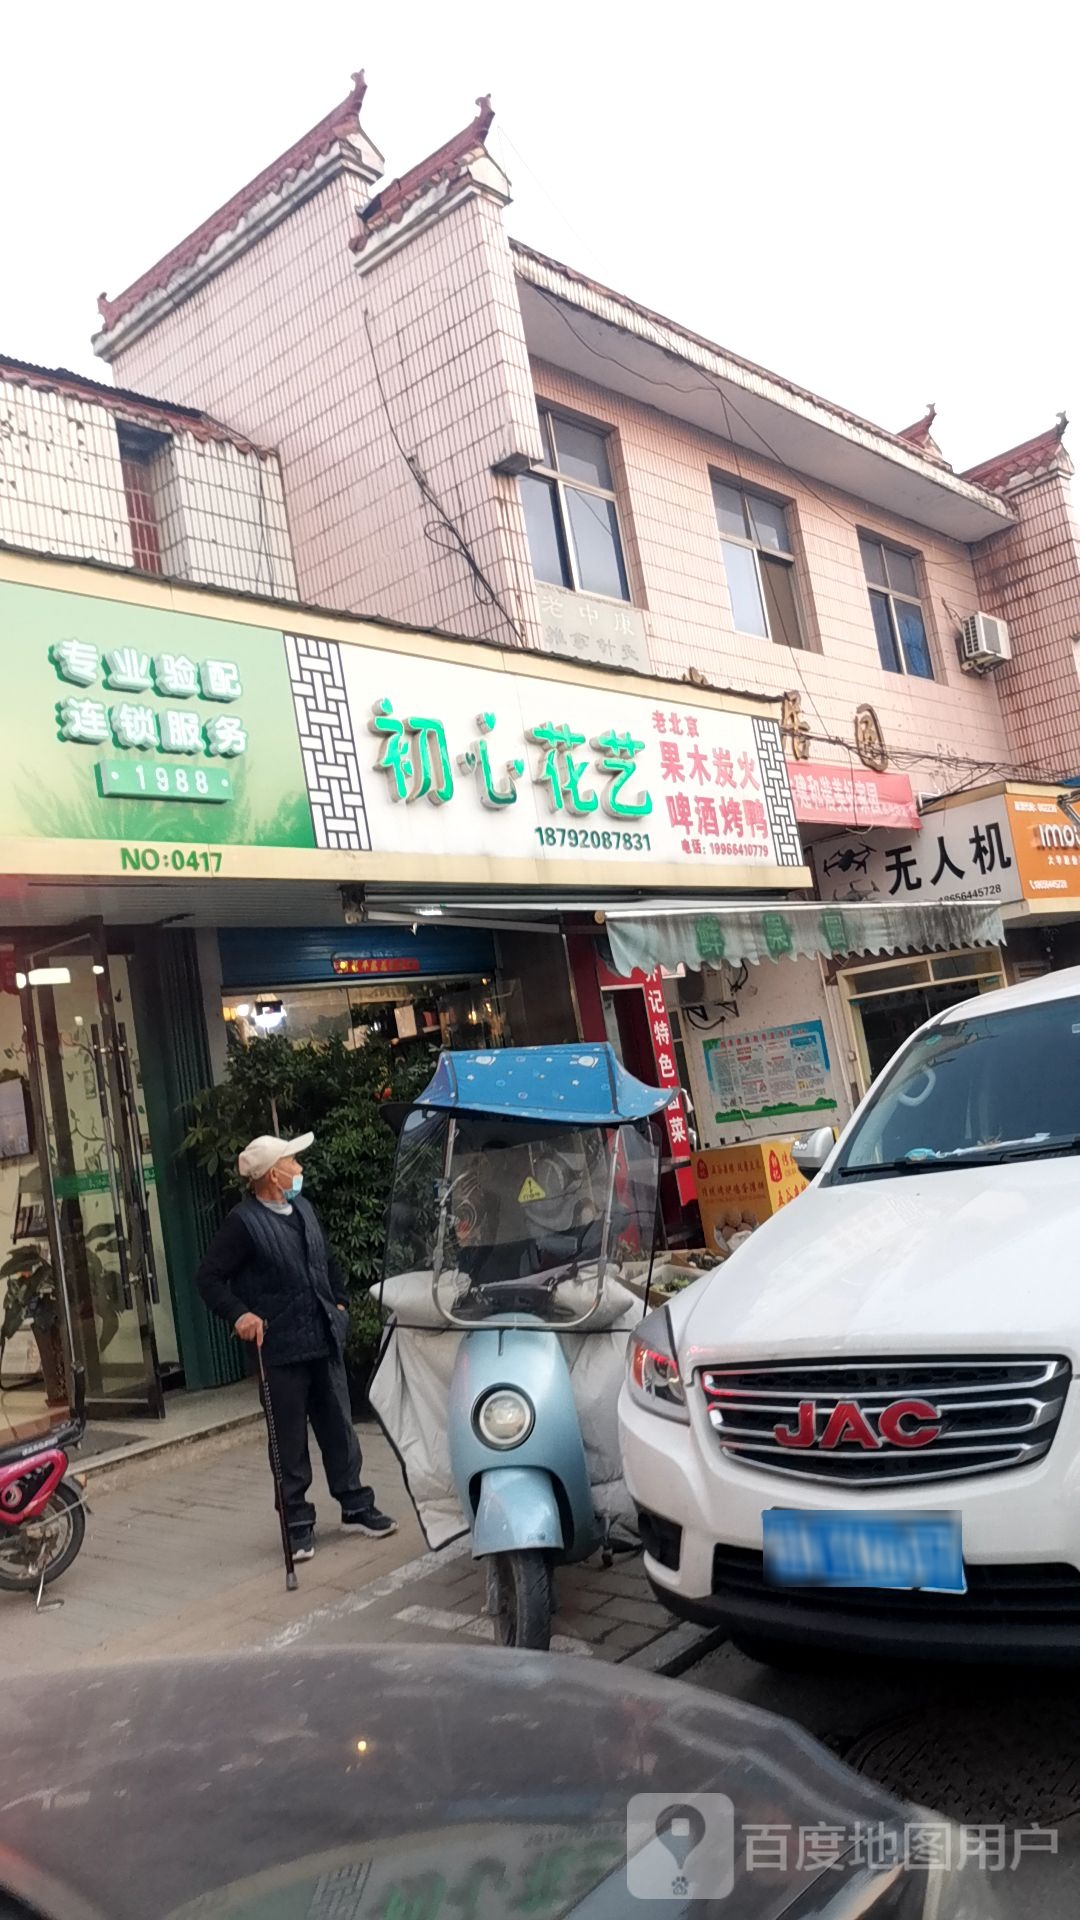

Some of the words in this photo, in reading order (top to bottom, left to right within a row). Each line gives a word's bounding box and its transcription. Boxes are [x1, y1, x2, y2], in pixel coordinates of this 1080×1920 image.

[54, 638, 242, 702] 专业验配
[60, 697, 248, 757] 连锁服务
[652, 710, 699, 738] 老北京
[370, 697, 653, 818] 初心花艺
[660, 740, 761, 791] 果木炭火
[535, 826, 652, 852] 18792087831
[665, 792, 769, 839] 啤酒烤鸭
[121, 848, 223, 873] NO:0417
[885, 822, 1012, 896] 无人机
[773, 1398, 942, 1449] JAC
